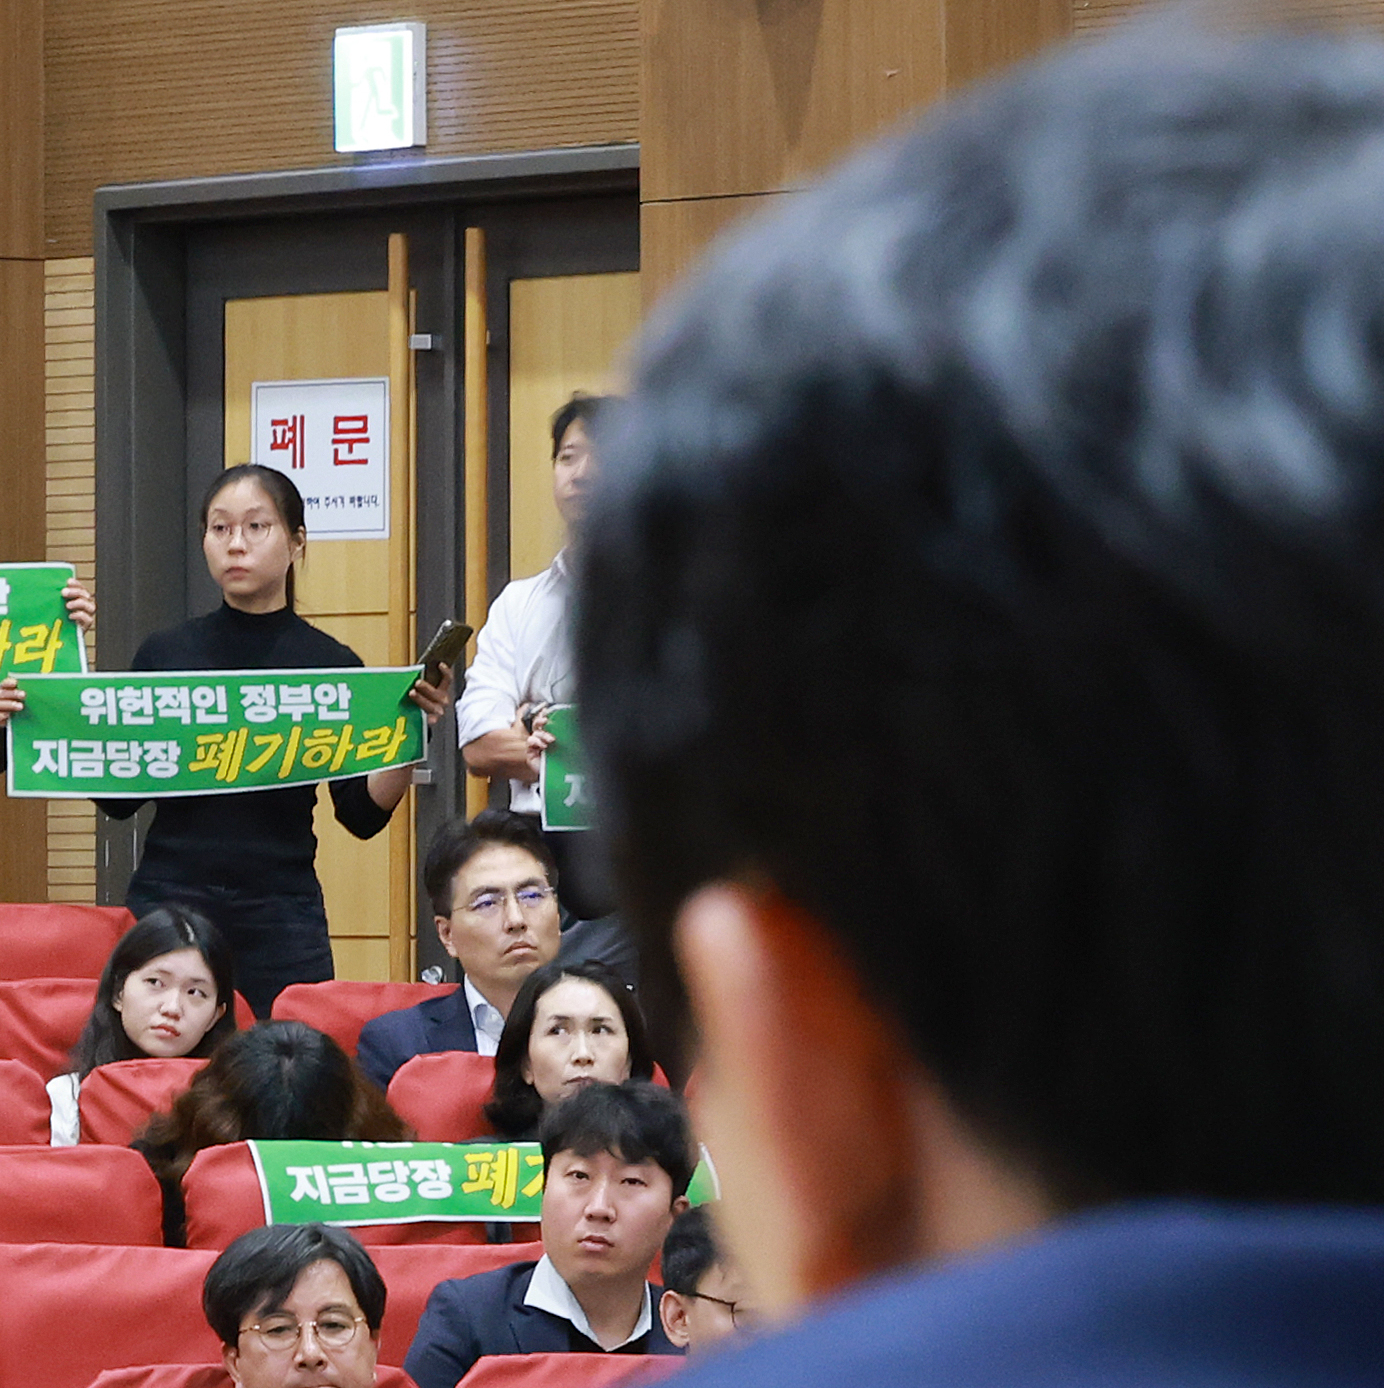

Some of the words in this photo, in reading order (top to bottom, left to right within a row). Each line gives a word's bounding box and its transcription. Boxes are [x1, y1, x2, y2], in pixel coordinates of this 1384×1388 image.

[80, 685, 229, 725] 위헌적인
[239, 682, 351, 723] 정부안
[31, 739, 182, 778] 지금당장
[188, 716, 407, 783] 폐기하라
[286, 1159, 453, 1204] 지금당장
